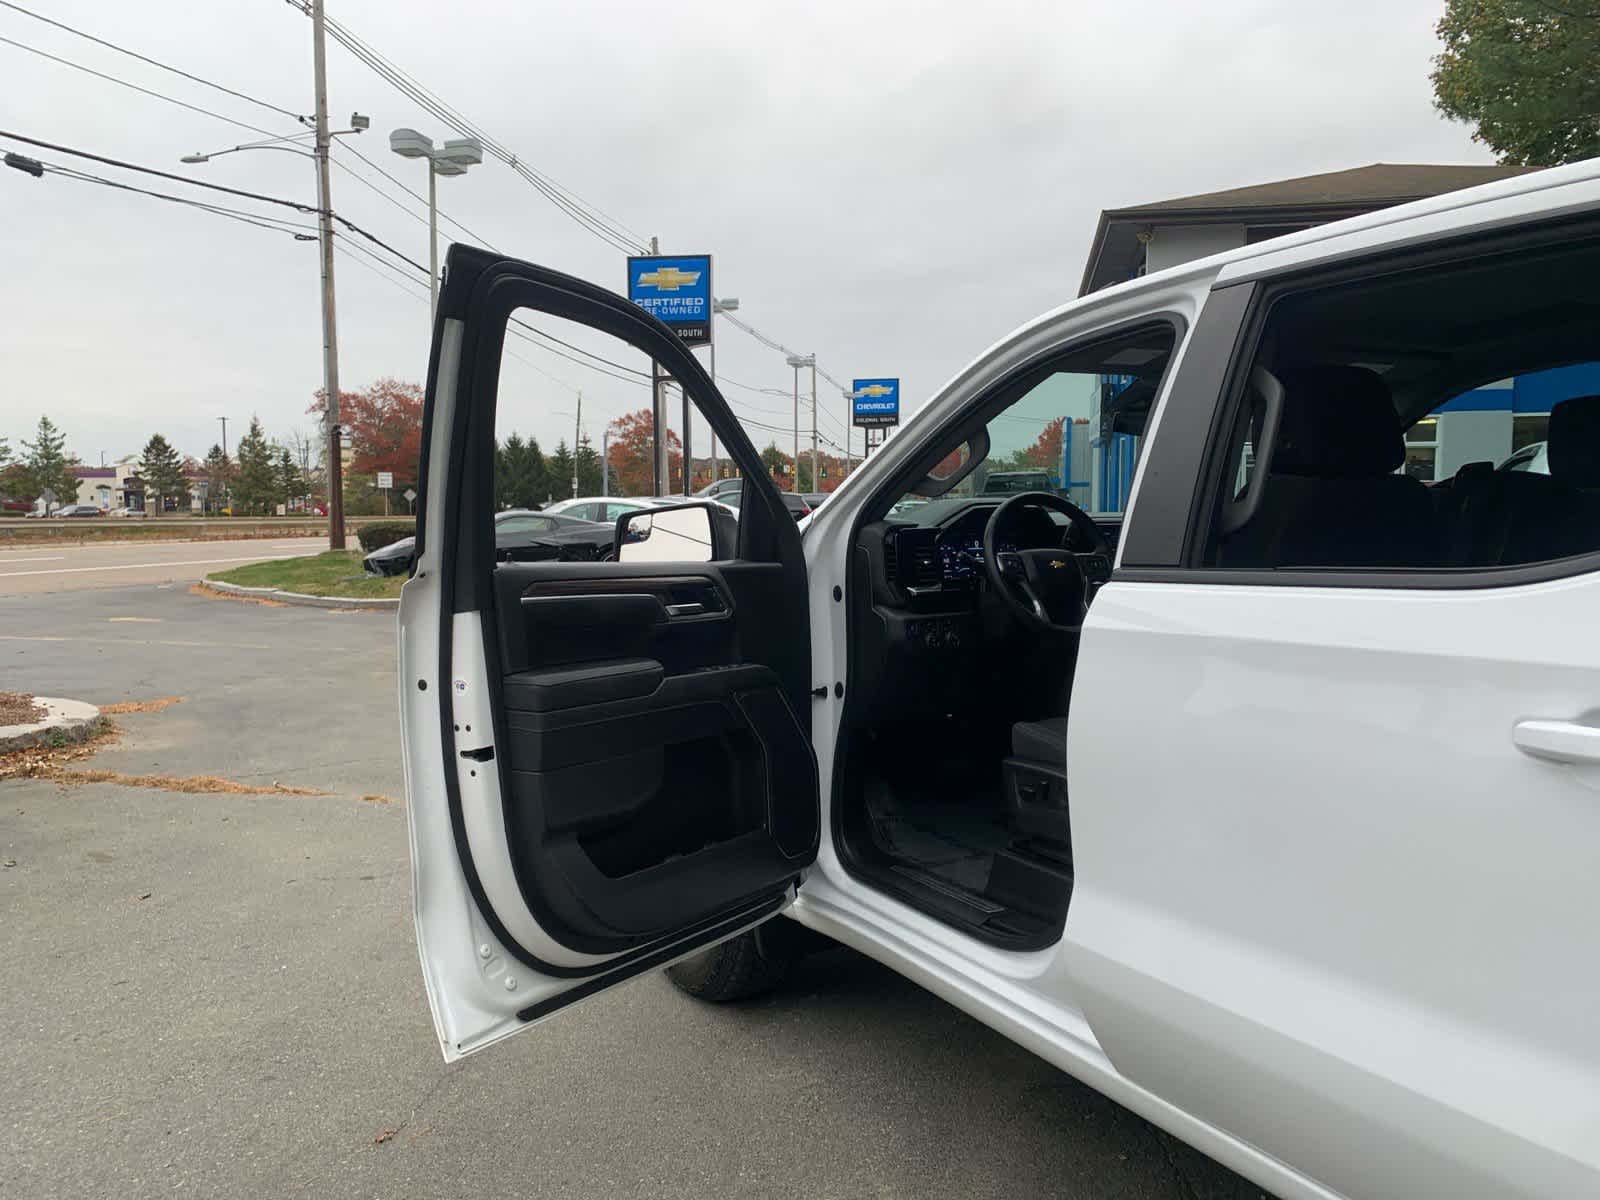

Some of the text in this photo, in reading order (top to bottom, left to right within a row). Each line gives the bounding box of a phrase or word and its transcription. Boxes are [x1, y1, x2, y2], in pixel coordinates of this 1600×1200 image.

[634, 297, 704, 307] CERTIFIED
[645, 306, 701, 315] RE-OWNED
[678, 328, 703, 337] SOUTH
